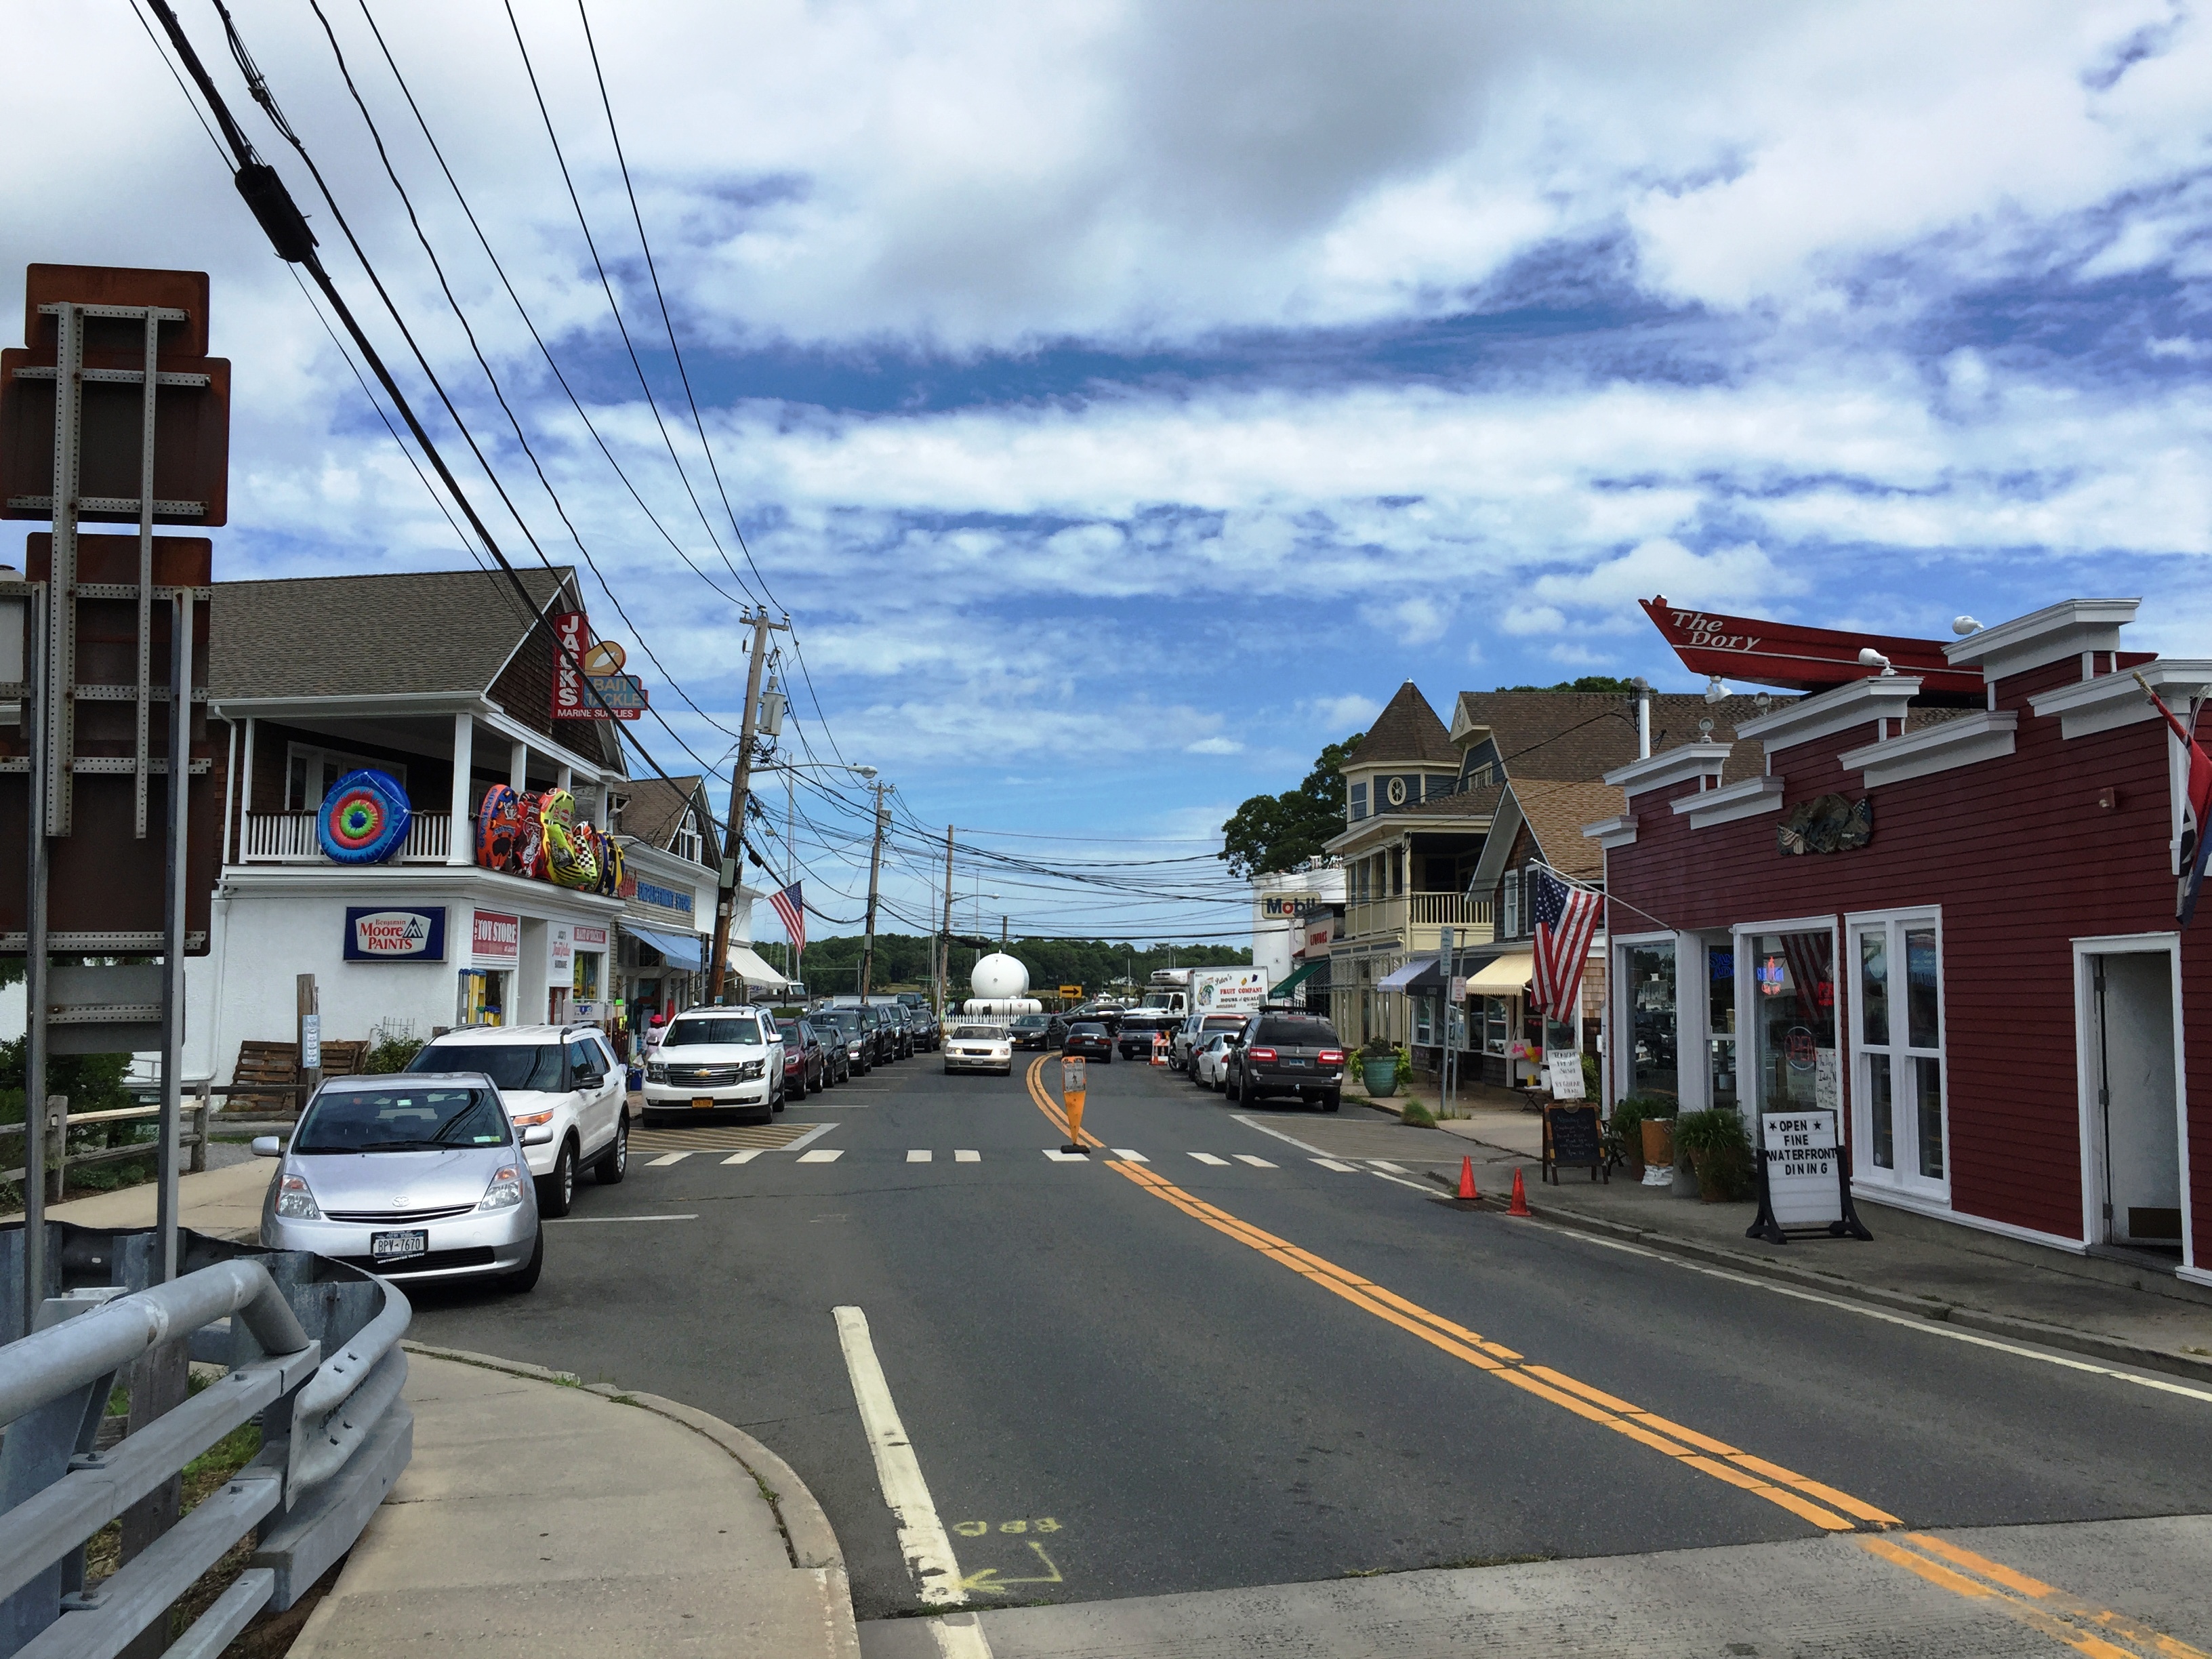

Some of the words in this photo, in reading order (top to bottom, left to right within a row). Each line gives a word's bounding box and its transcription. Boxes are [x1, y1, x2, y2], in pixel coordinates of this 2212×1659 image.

[1671, 611, 1723, 632] The
[1689, 631, 1762, 652] Dory
[594, 678, 628, 691] BAIT
[558, 709, 592, 717] MARINE
[375, 918, 406, 926] Benjamin
[359, 922, 403, 937] Moore
[478, 920, 493, 941] TOY
[493, 922, 516, 943] STORE
[368, 937, 413, 949] PAINTS
[1780, 1120, 1807, 1132] OPEN
[1784, 1134, 1809, 1146] FINE
[1767, 1148, 1837, 1162] WATERFRONT
[1785, 1163, 1828, 1175] DINING
